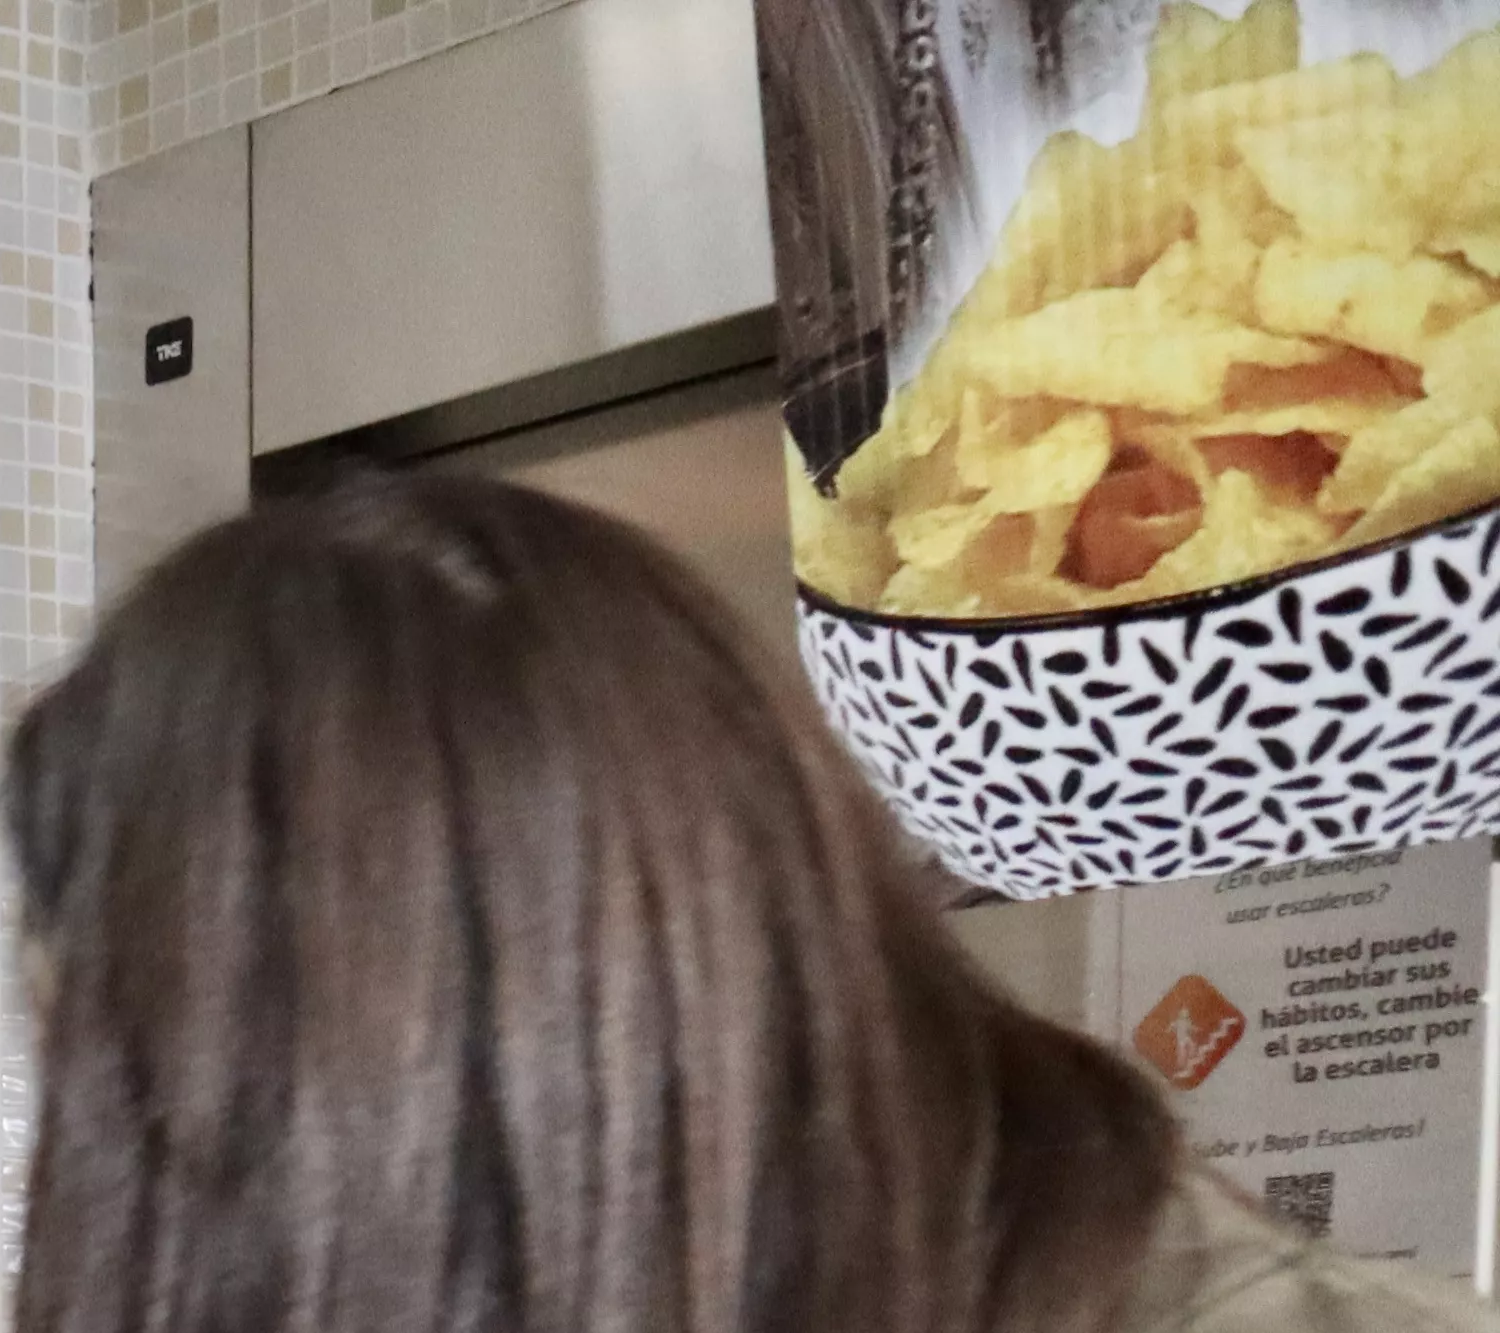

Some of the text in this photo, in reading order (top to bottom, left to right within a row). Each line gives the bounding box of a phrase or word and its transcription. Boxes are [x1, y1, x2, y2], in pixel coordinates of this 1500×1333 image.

[1284, 926, 1457, 969] Usted puede
[1288, 960, 1451, 997] cambiar sus
[1261, 984, 1480, 1029] hábitos, cambie
[1263, 1017, 1473, 1057] el ascensor por
[1293, 1051, 1440, 1083] la escalera
